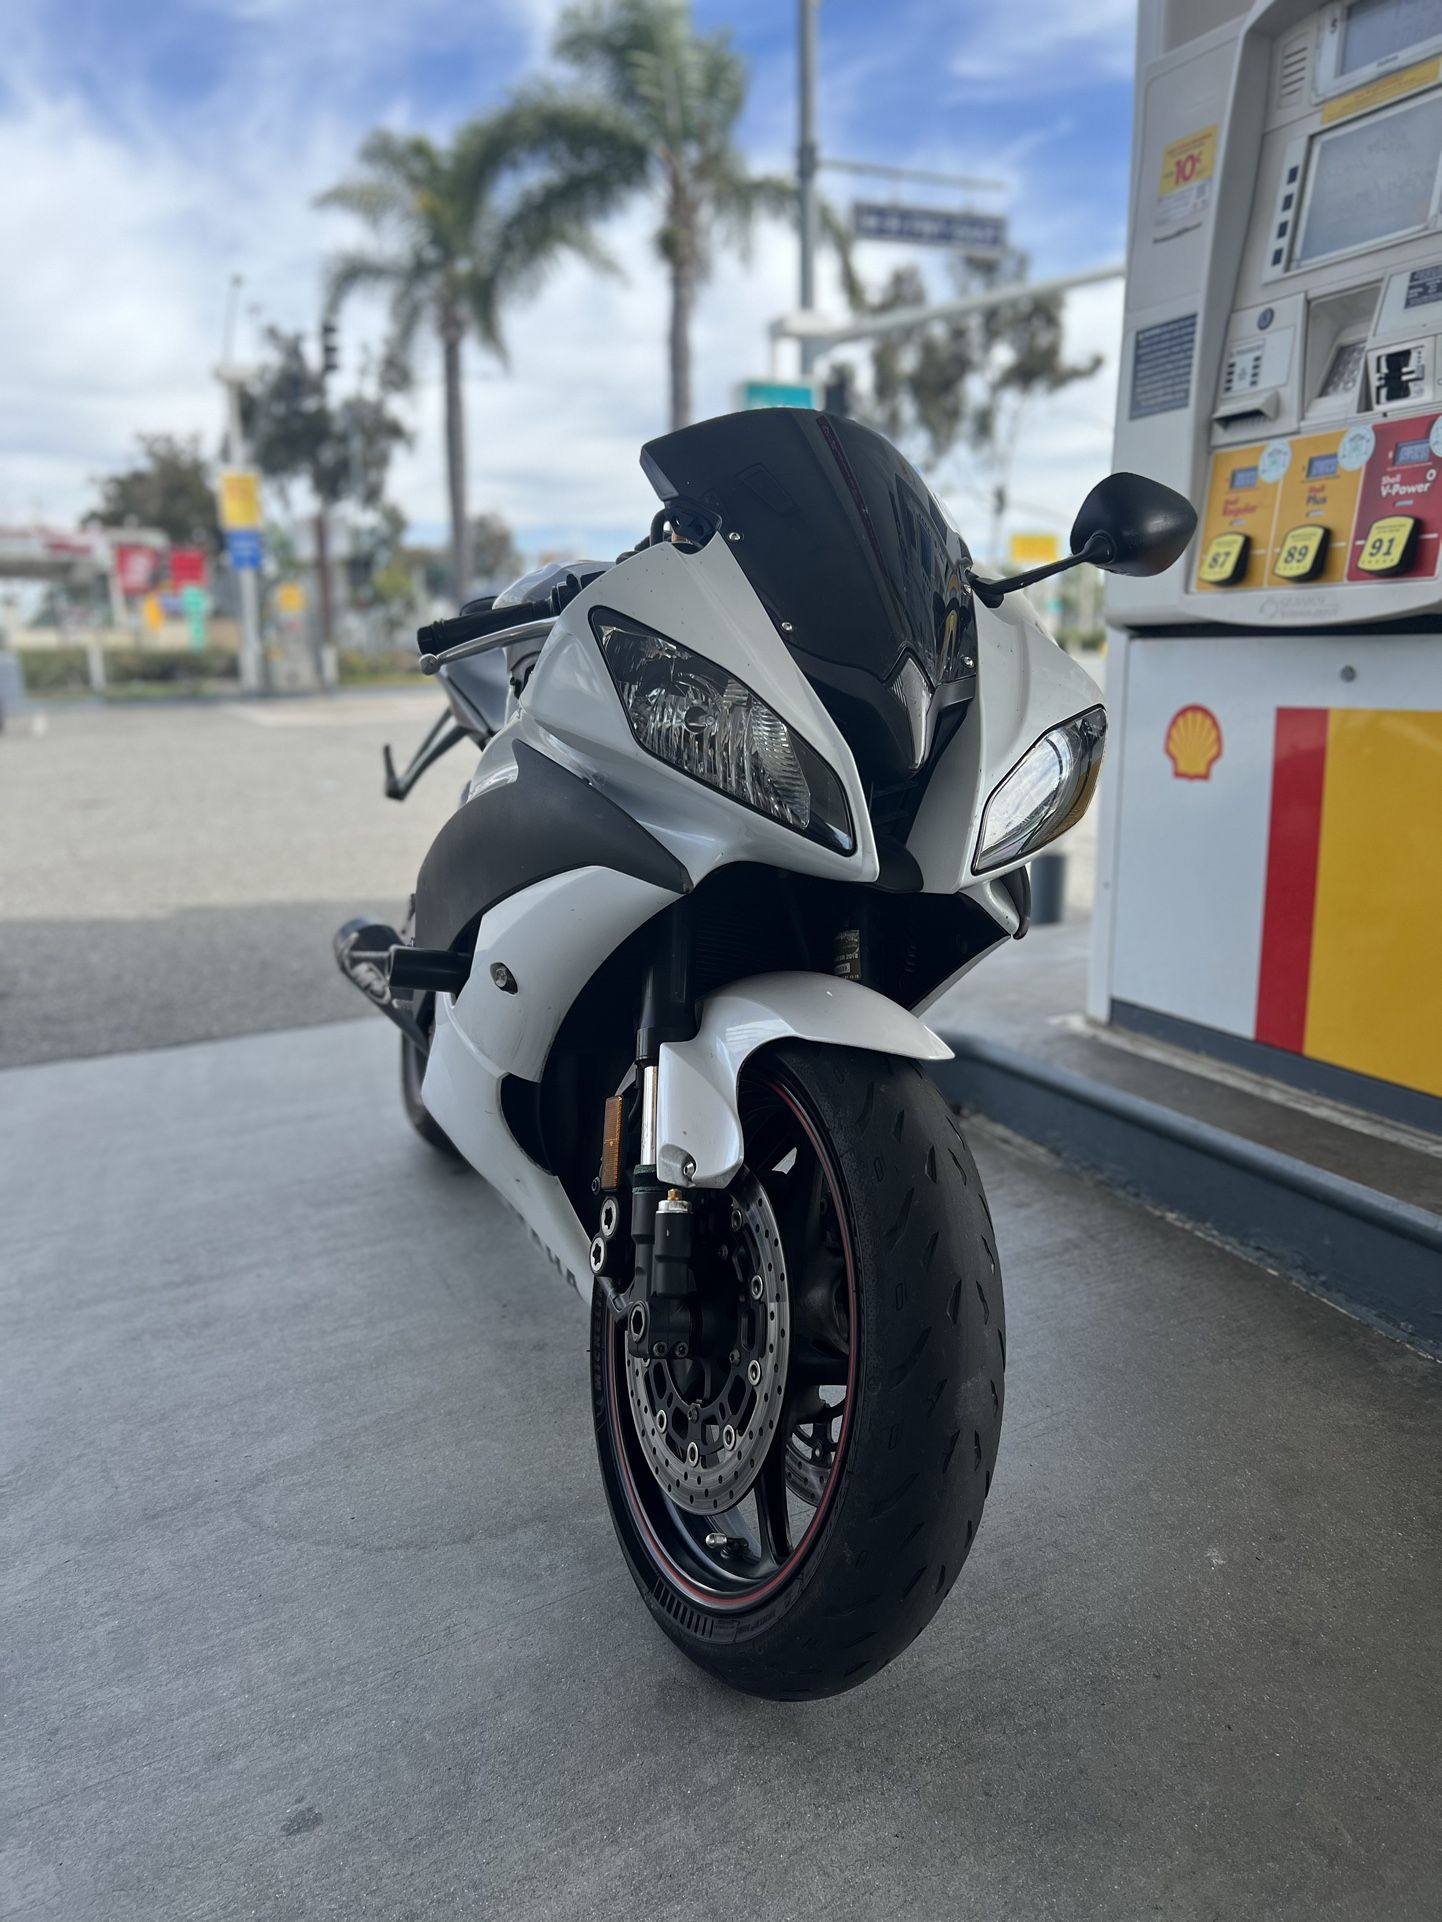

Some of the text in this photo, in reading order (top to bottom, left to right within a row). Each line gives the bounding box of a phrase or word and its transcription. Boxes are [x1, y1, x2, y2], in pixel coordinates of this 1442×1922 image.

[1380, 474, 1401, 485] Shell
[1380, 482, 1431, 497] V-Power
[1283, 545, 1309, 564] 89
[1368, 536, 1396, 558] 91
[1209, 551, 1232, 569] 87
